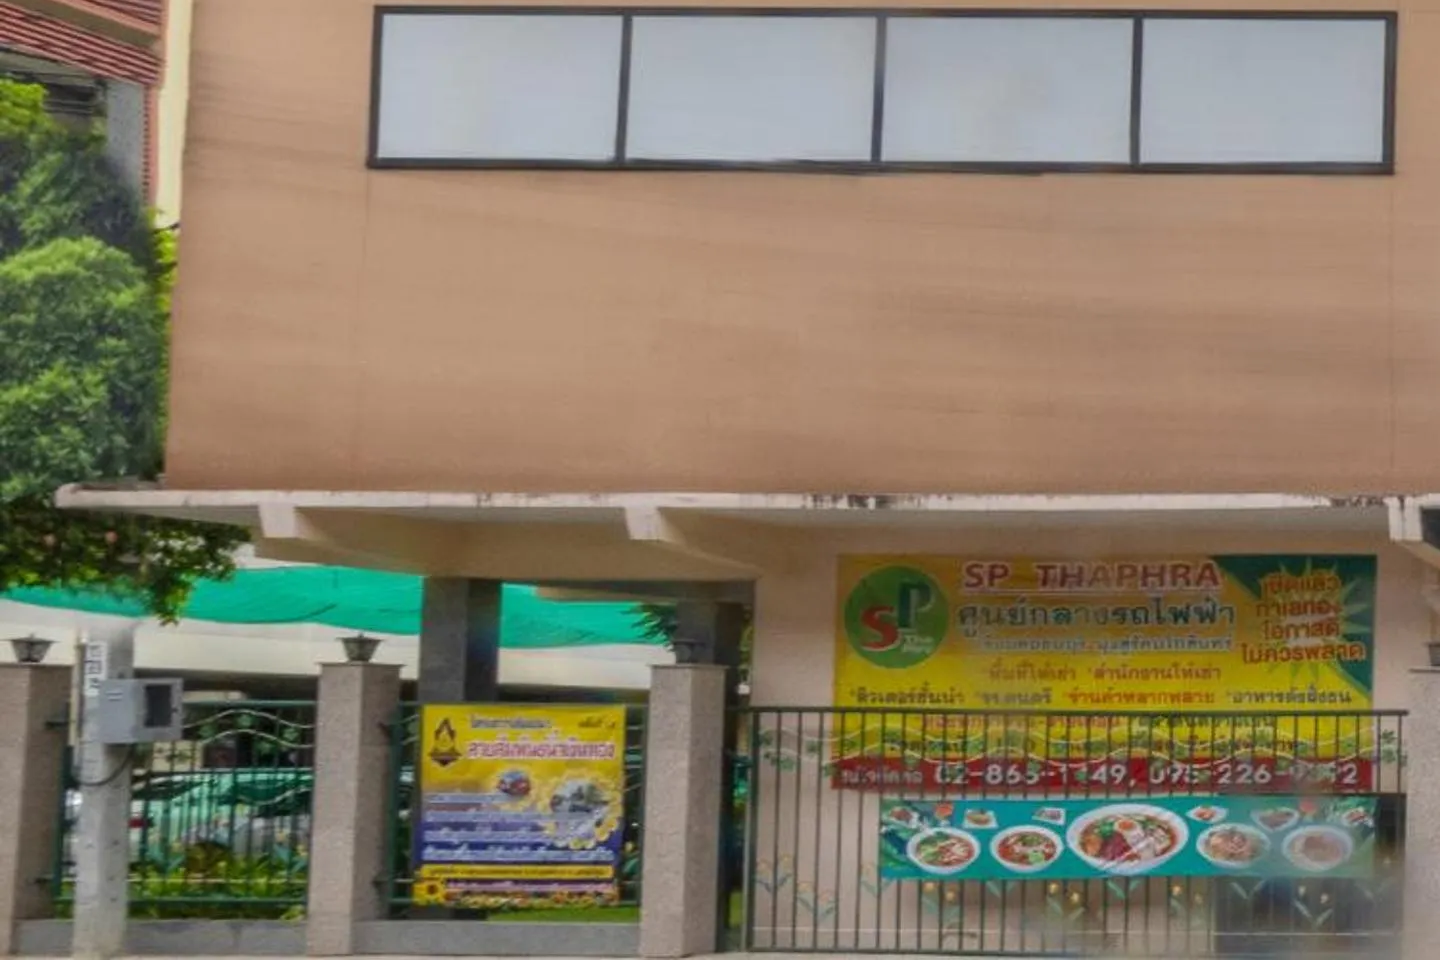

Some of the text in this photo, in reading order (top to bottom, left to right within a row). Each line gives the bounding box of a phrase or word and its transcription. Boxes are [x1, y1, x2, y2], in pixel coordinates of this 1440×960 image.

[964, 562, 1221, 588] SP THAPHRA
[958, 595, 1235, 637] ศูนย์กลางรถไฟฟ้า
